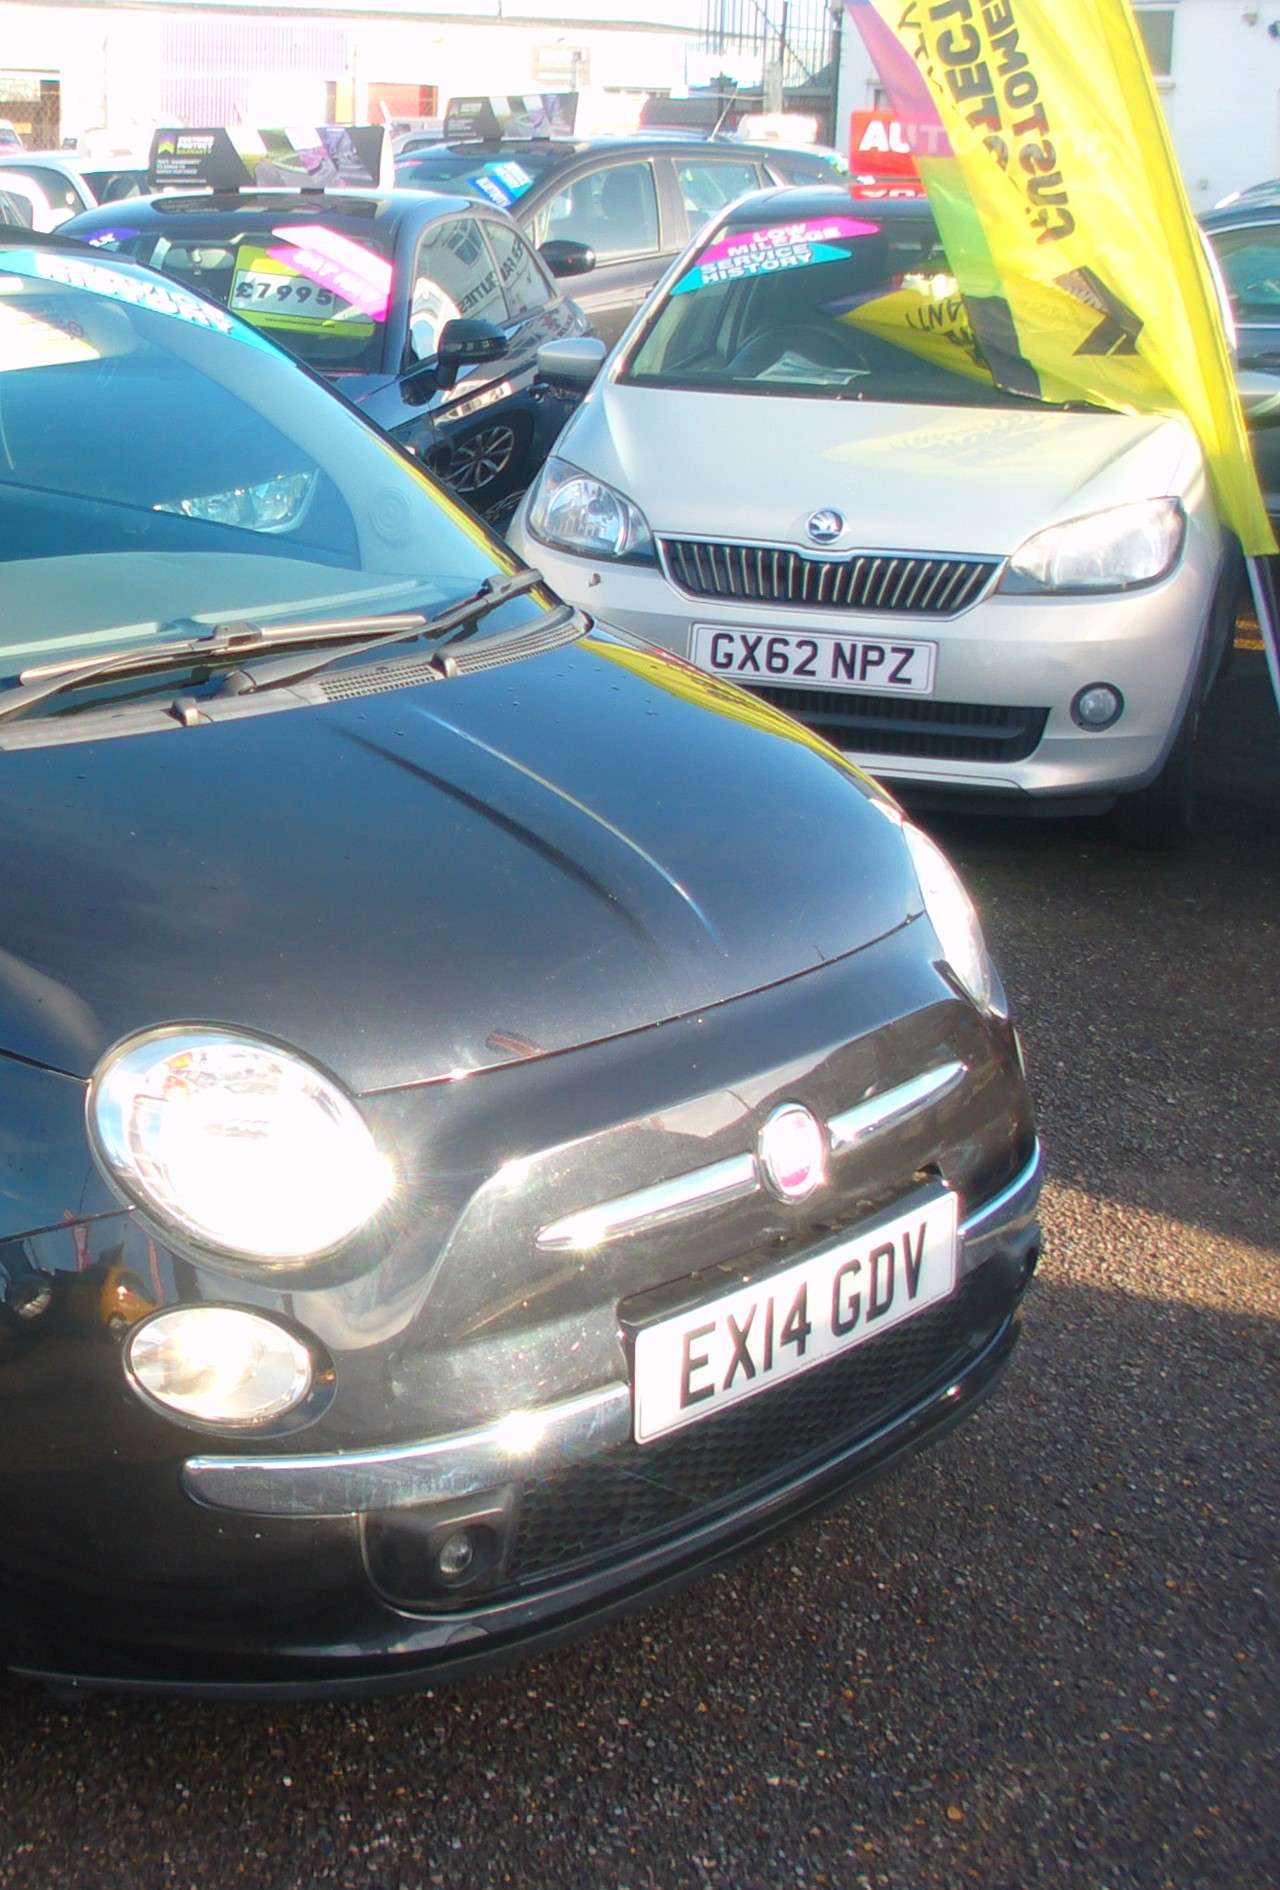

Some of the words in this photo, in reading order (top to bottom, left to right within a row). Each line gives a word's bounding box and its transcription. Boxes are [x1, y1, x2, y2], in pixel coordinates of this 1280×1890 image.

[727, 226, 841, 257] MILEAGE
[752, 223, 807, 244] LOW
[700, 243, 810, 274] SERVICE
[701, 253, 812, 285] HISTORY
[235, 281, 333, 307] £7995
[710, 632, 818, 677] GX62
[830, 642, 915, 685] NPZ
[680, 1281, 812, 1410] EX14
[831, 1221, 927, 1338] GDV
